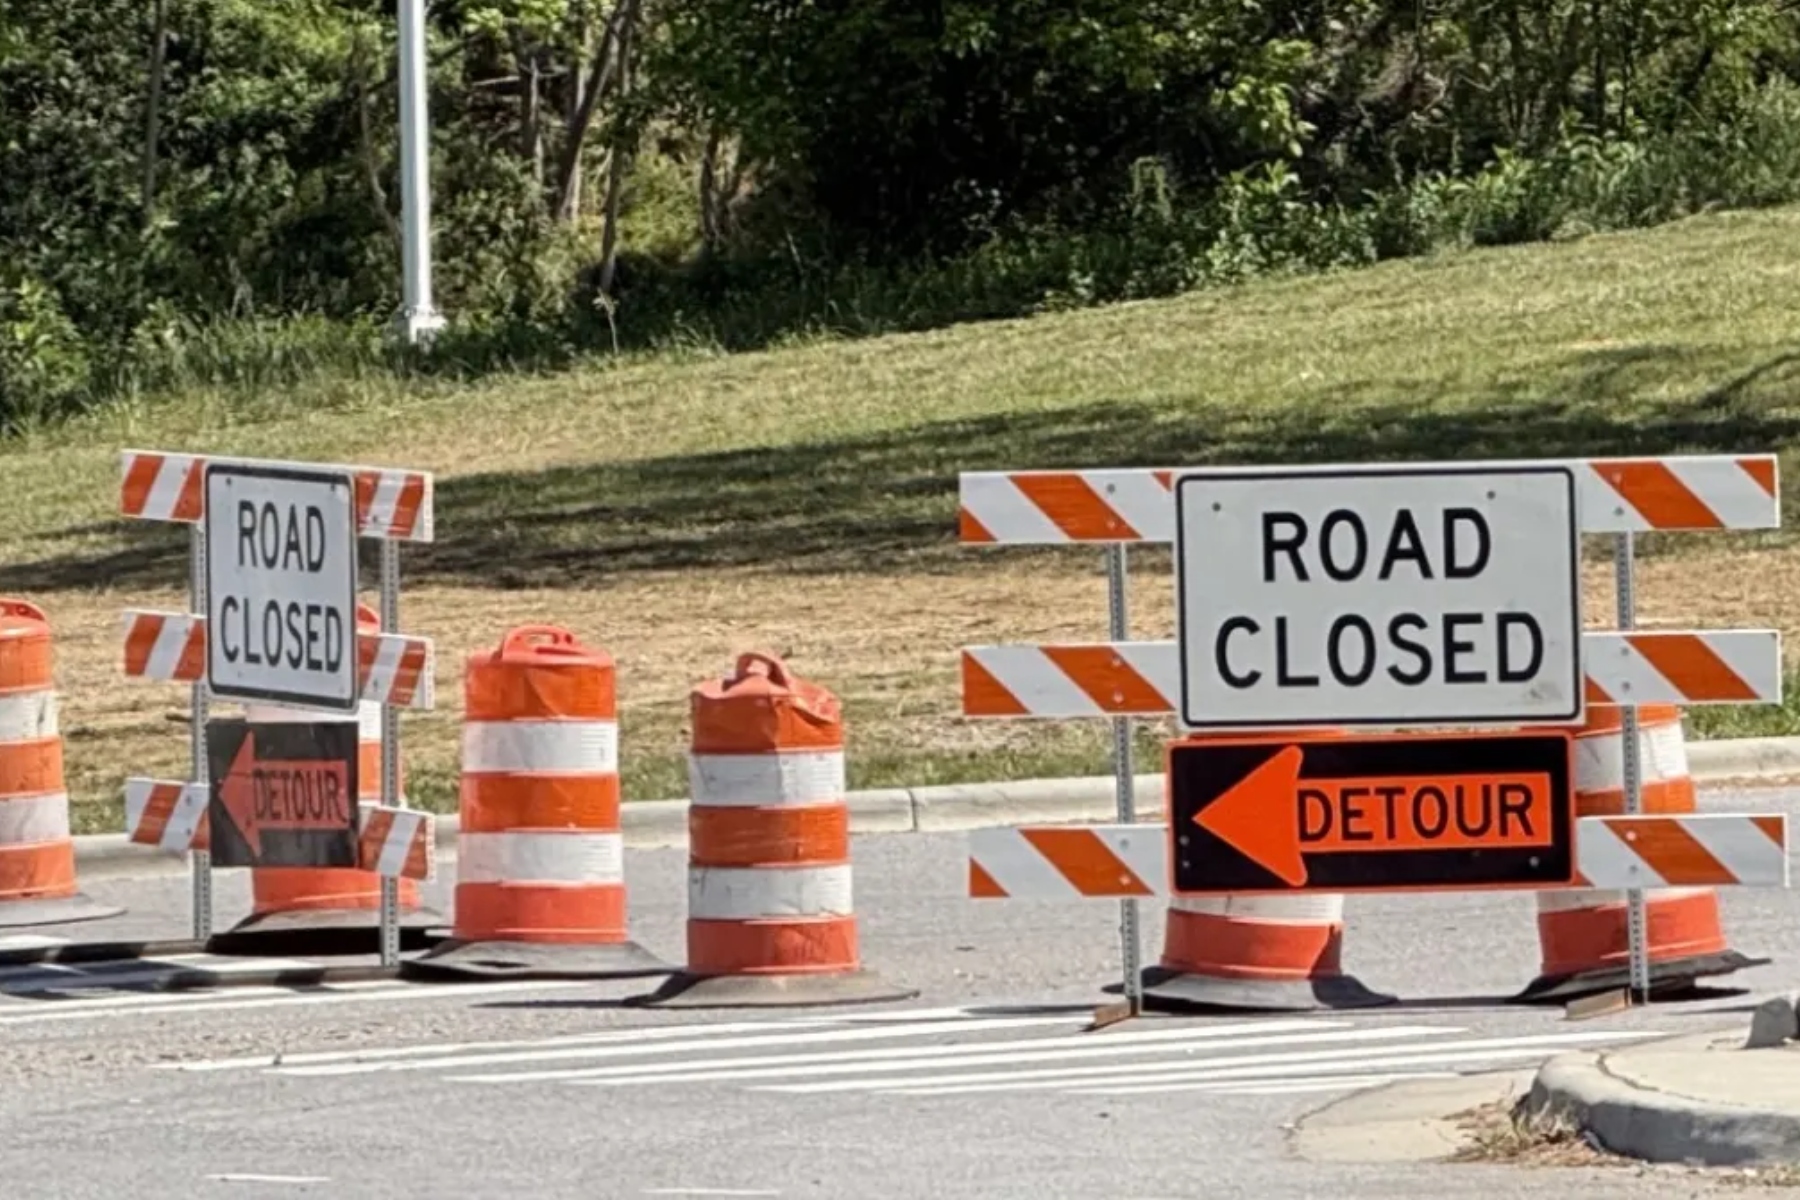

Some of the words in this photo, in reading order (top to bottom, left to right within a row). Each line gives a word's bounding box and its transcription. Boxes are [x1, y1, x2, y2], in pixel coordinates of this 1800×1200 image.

[238, 500, 326, 573] ROAD
[1262, 508, 1491, 583] ROAD
[220, 596, 342, 673] CLOSED
[1214, 611, 1544, 689] CLOSED
[252, 769, 345, 823] DETOUR
[1299, 784, 1534, 842] DETOUR
